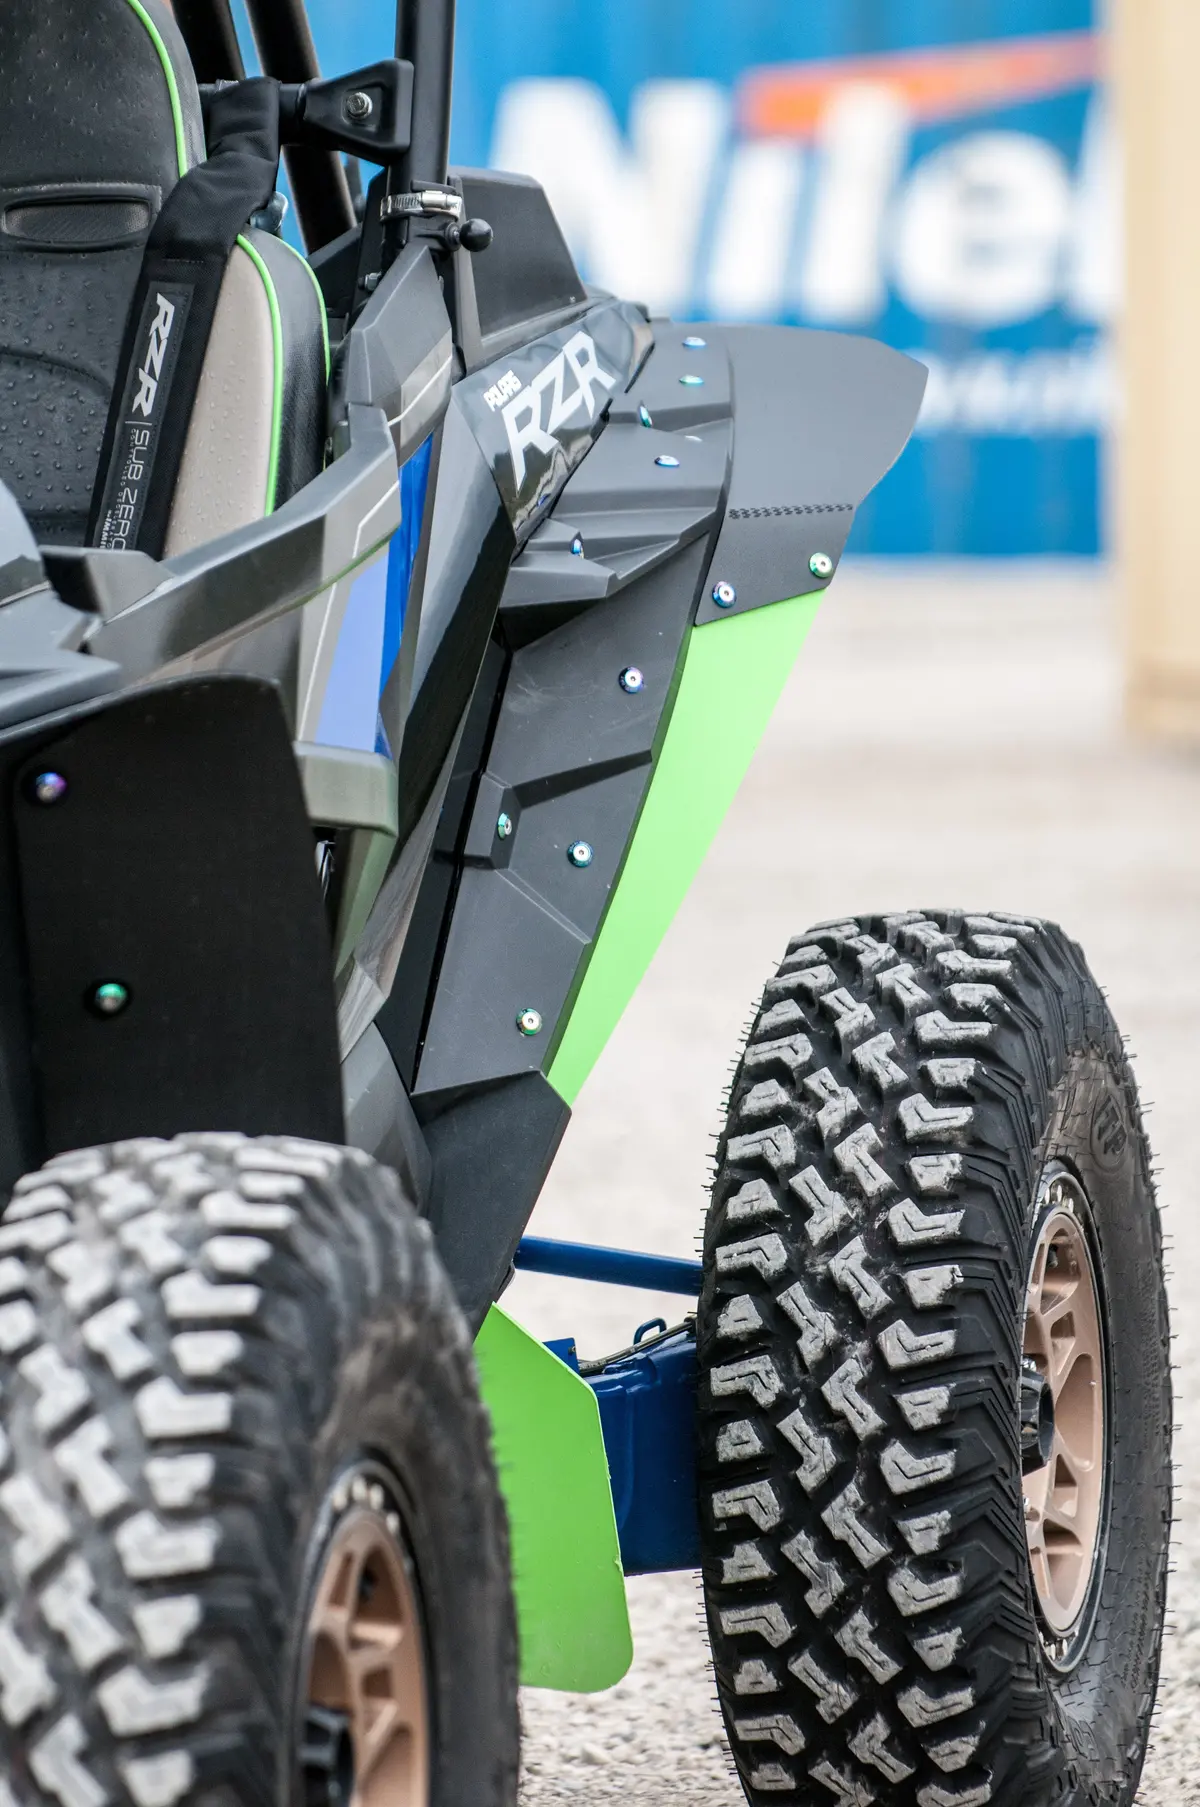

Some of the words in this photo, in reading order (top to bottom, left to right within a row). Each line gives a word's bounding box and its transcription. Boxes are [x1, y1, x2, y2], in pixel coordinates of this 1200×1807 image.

[131, 292, 175, 417] RZR
[127, 429, 150, 480] SUB
[501, 331, 617, 493] RZR
[106, 491, 124, 549] DECELERATO
